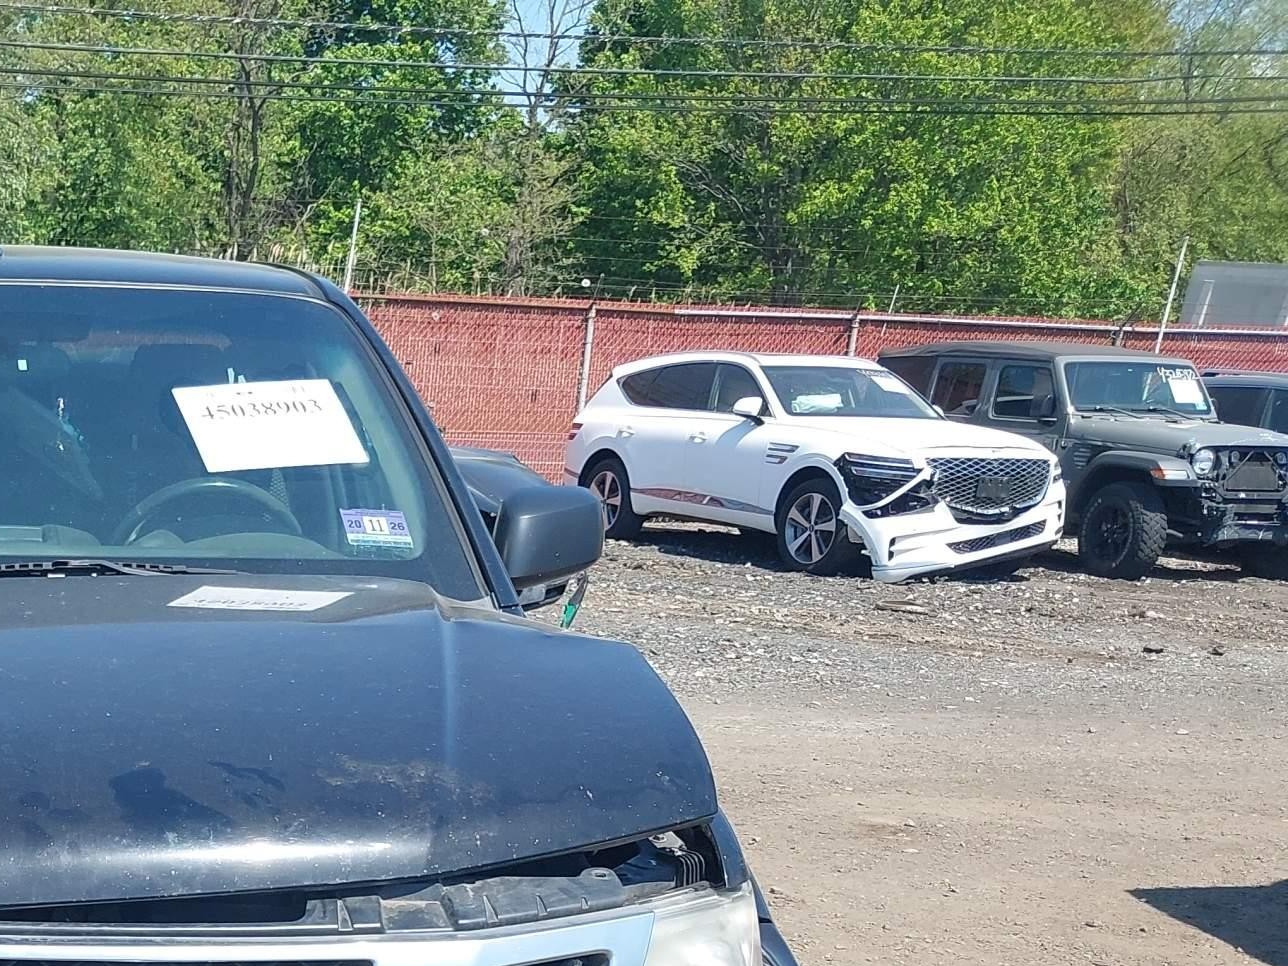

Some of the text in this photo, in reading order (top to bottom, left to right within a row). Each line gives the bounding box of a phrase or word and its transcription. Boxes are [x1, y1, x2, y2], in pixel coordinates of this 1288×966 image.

[201, 399, 323, 420] 45038903
[347, 519, 405, 532] 20 11 26
